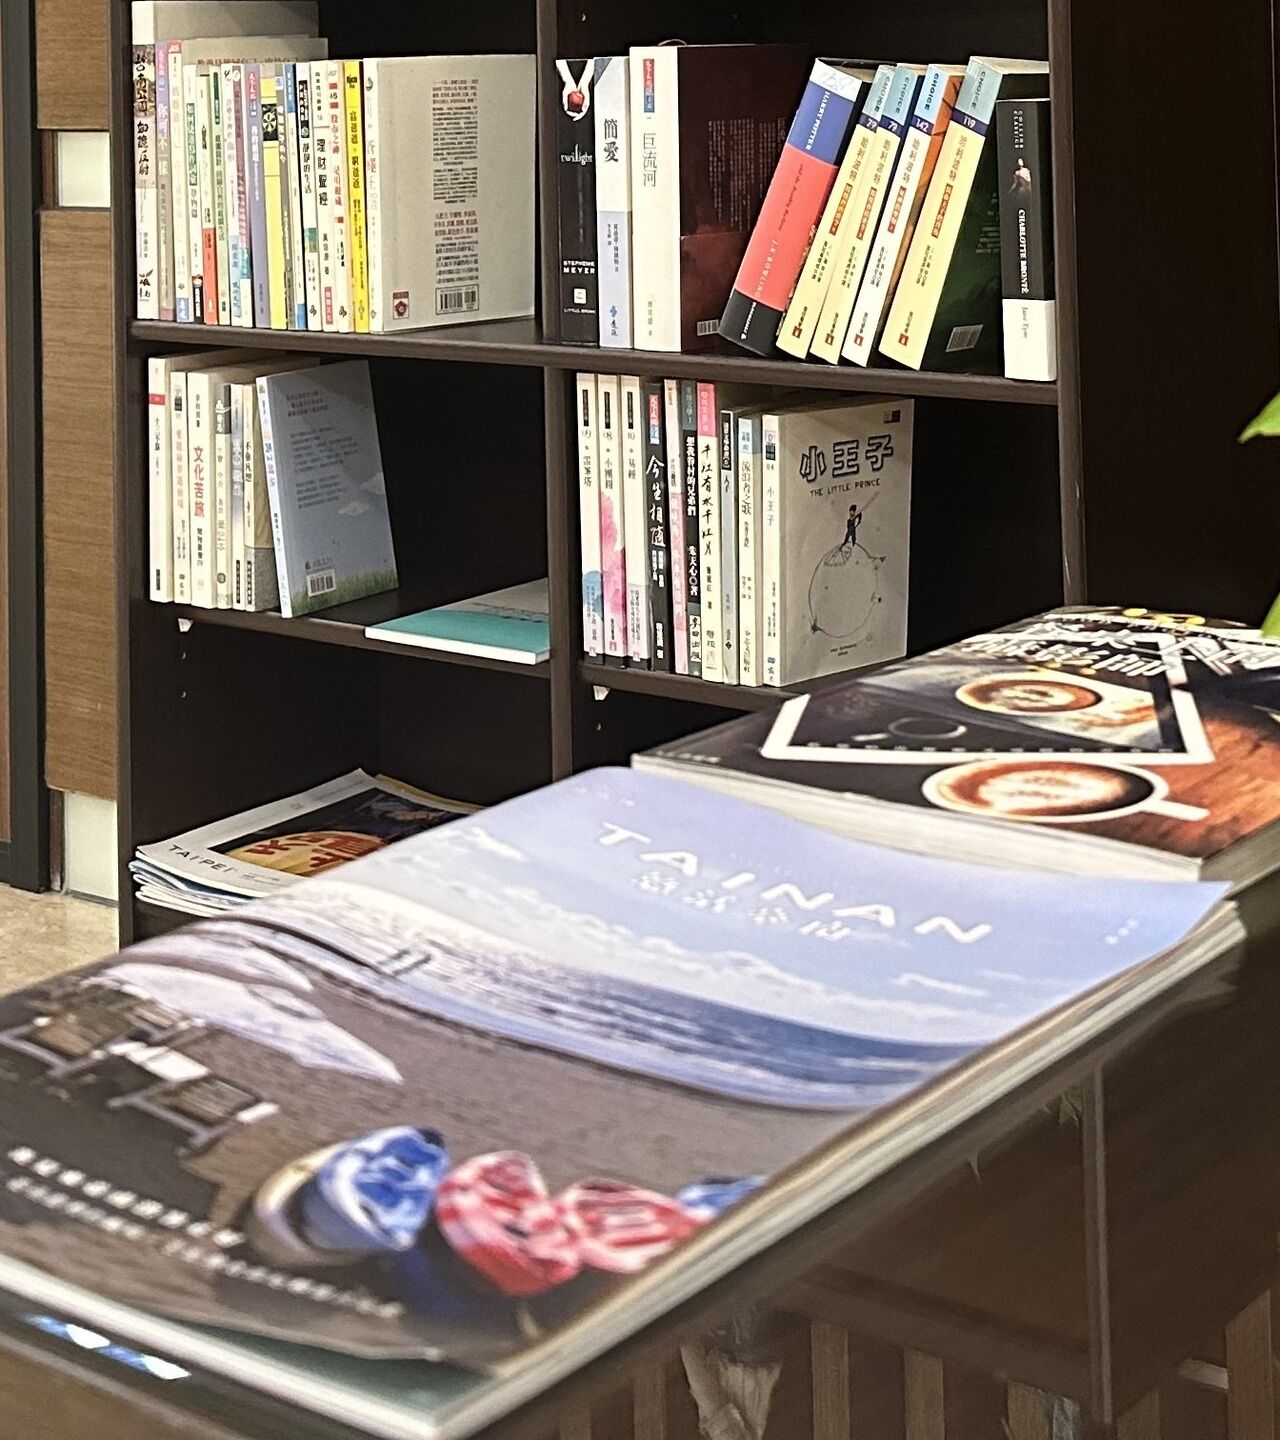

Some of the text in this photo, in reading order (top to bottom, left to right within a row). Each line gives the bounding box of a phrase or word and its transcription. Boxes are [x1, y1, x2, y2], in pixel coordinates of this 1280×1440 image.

[874, 76, 890, 113] CHOICE
[895, 77, 909, 114] CHOICE
[924, 73, 939, 111] CHOICE
[972, 70, 986, 109] CHOICE
[805, 119, 821, 151] POTTER
[916, 120, 929, 132] 142
[963, 117, 976, 128] 119
[561, 144, 593, 166] twilight
[643, 133, 657, 187] 巨流河
[1019, 209, 1027, 259] CHARLOTTE
[799, 434, 894, 483] 小王子
[193, 446, 205, 517] 文化苦旅
[701, 443, 713, 556] 千江有水千江月
[810, 478, 880, 497] THE LITTLE PRINCE
[646, 455, 666, 547] 今生相隨
[766, 486, 775, 527] 小王子
[169, 844, 234, 873] TAIPEI
[598, 821, 994, 945] TAINAN
